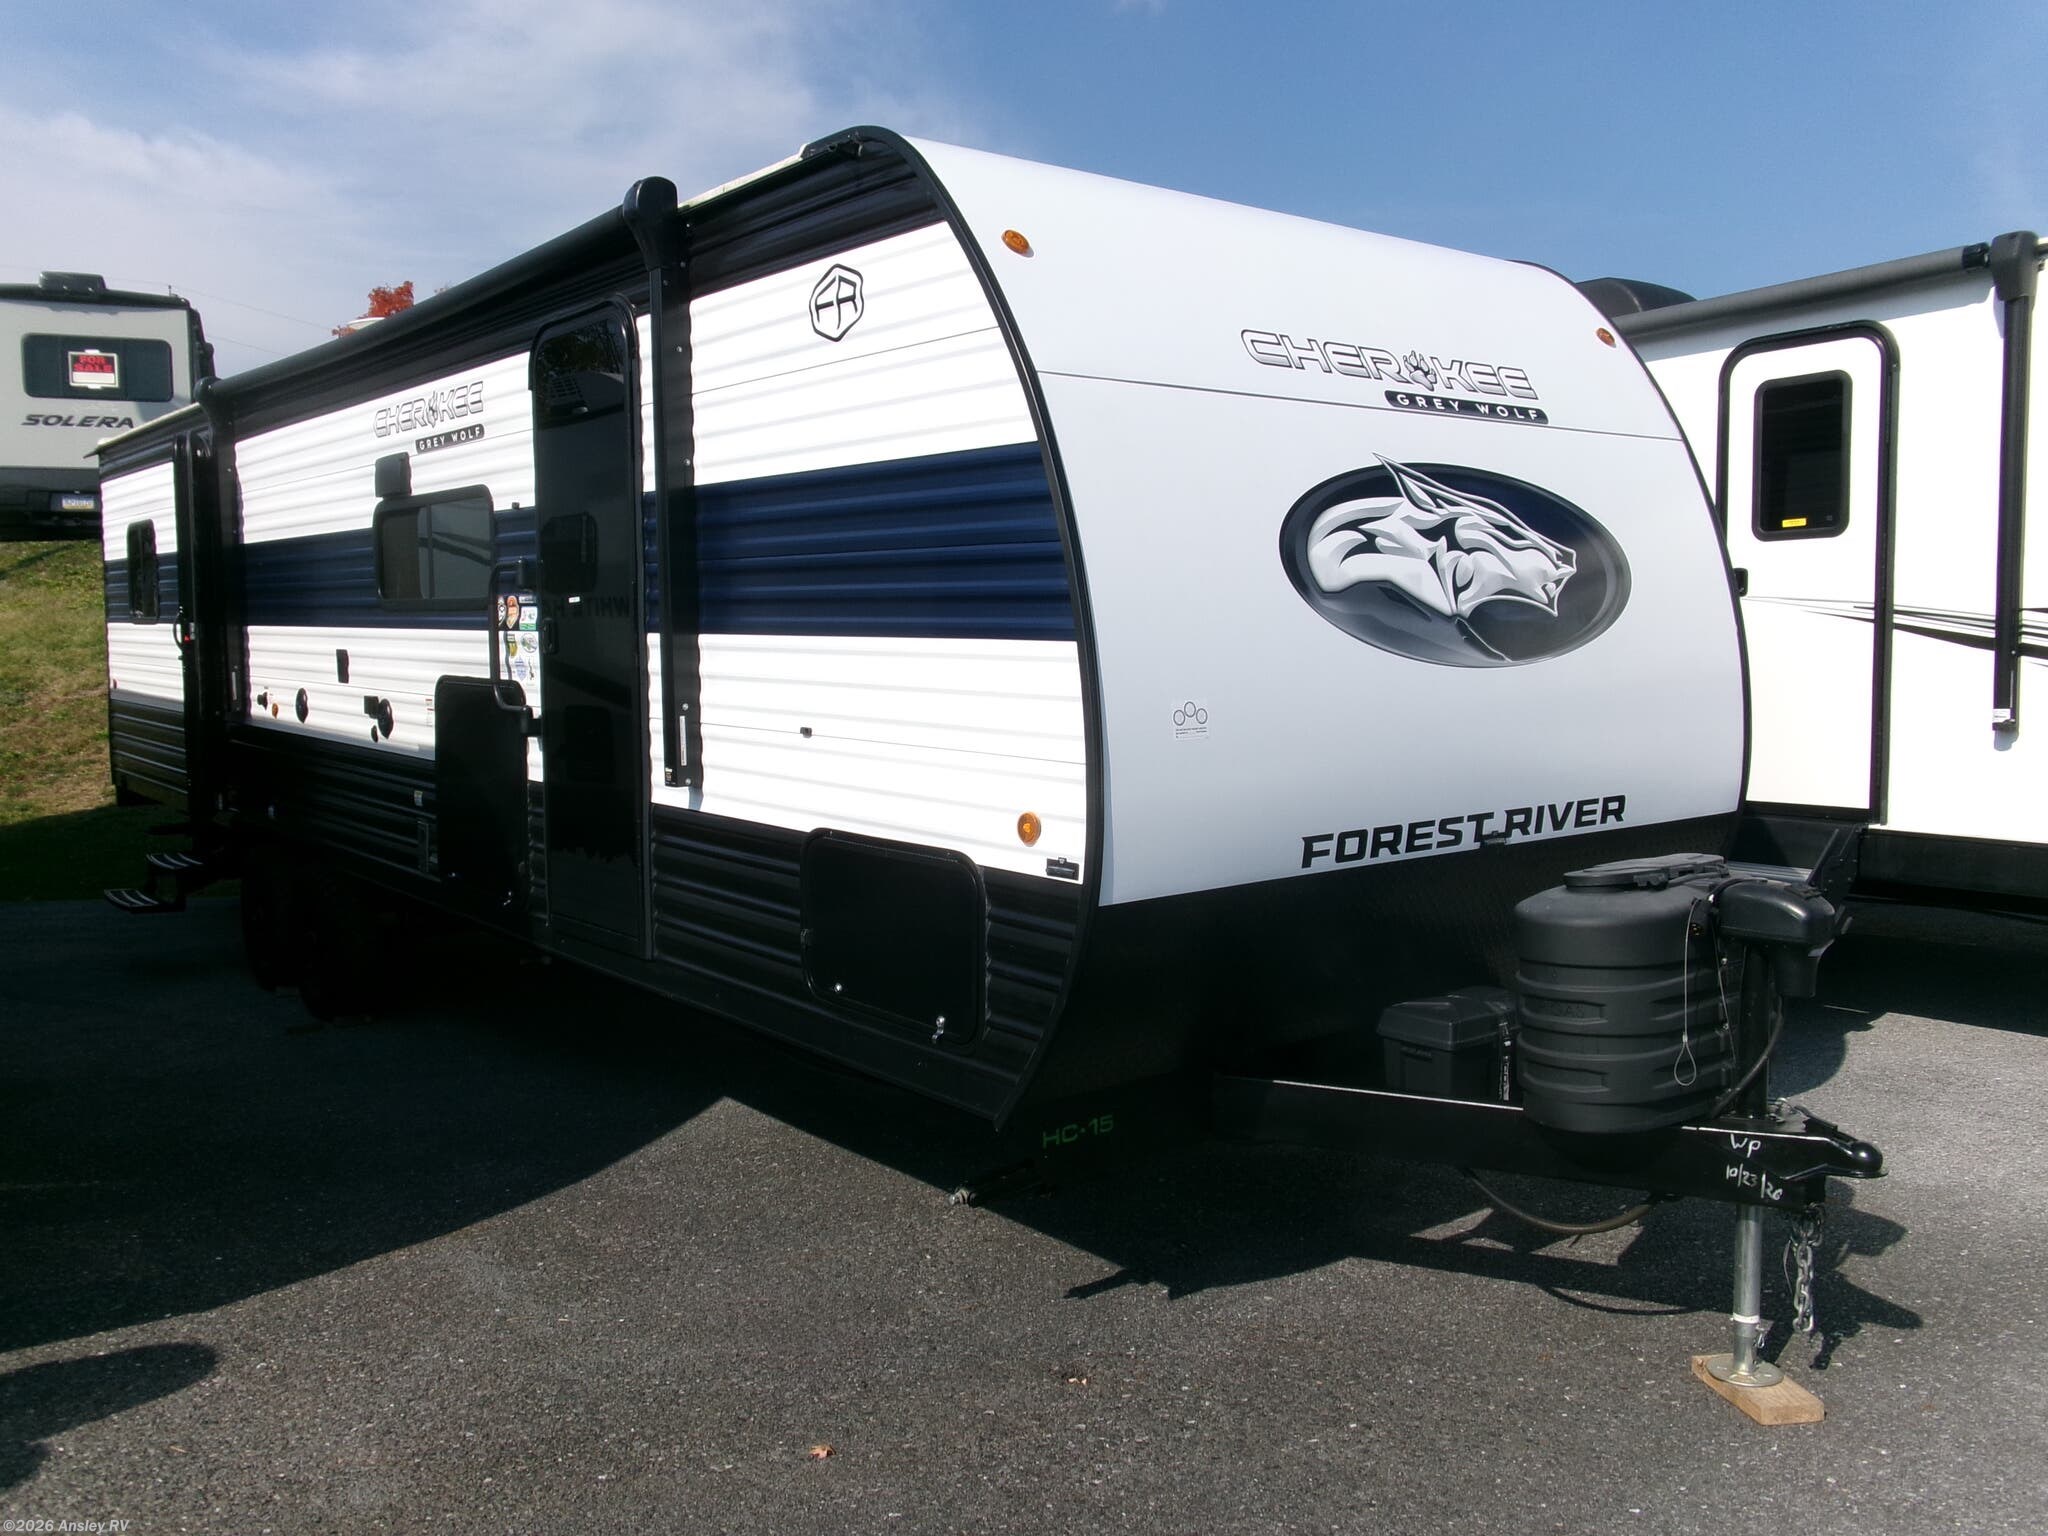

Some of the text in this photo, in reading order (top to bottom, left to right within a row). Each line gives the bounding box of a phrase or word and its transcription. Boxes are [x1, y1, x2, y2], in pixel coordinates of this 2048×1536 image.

[73, 363, 113, 373] SALE
[79, 354, 105, 365] FOR
[1241, 329, 1539, 400] CHEROKEE
[1397, 394, 1539, 420] GREY WOLF
[20, 413, 135, 429] SOLERA
[419, 427, 480, 450] GREY WOLF
[1301, 795, 1627, 869] FOREST RIVER
